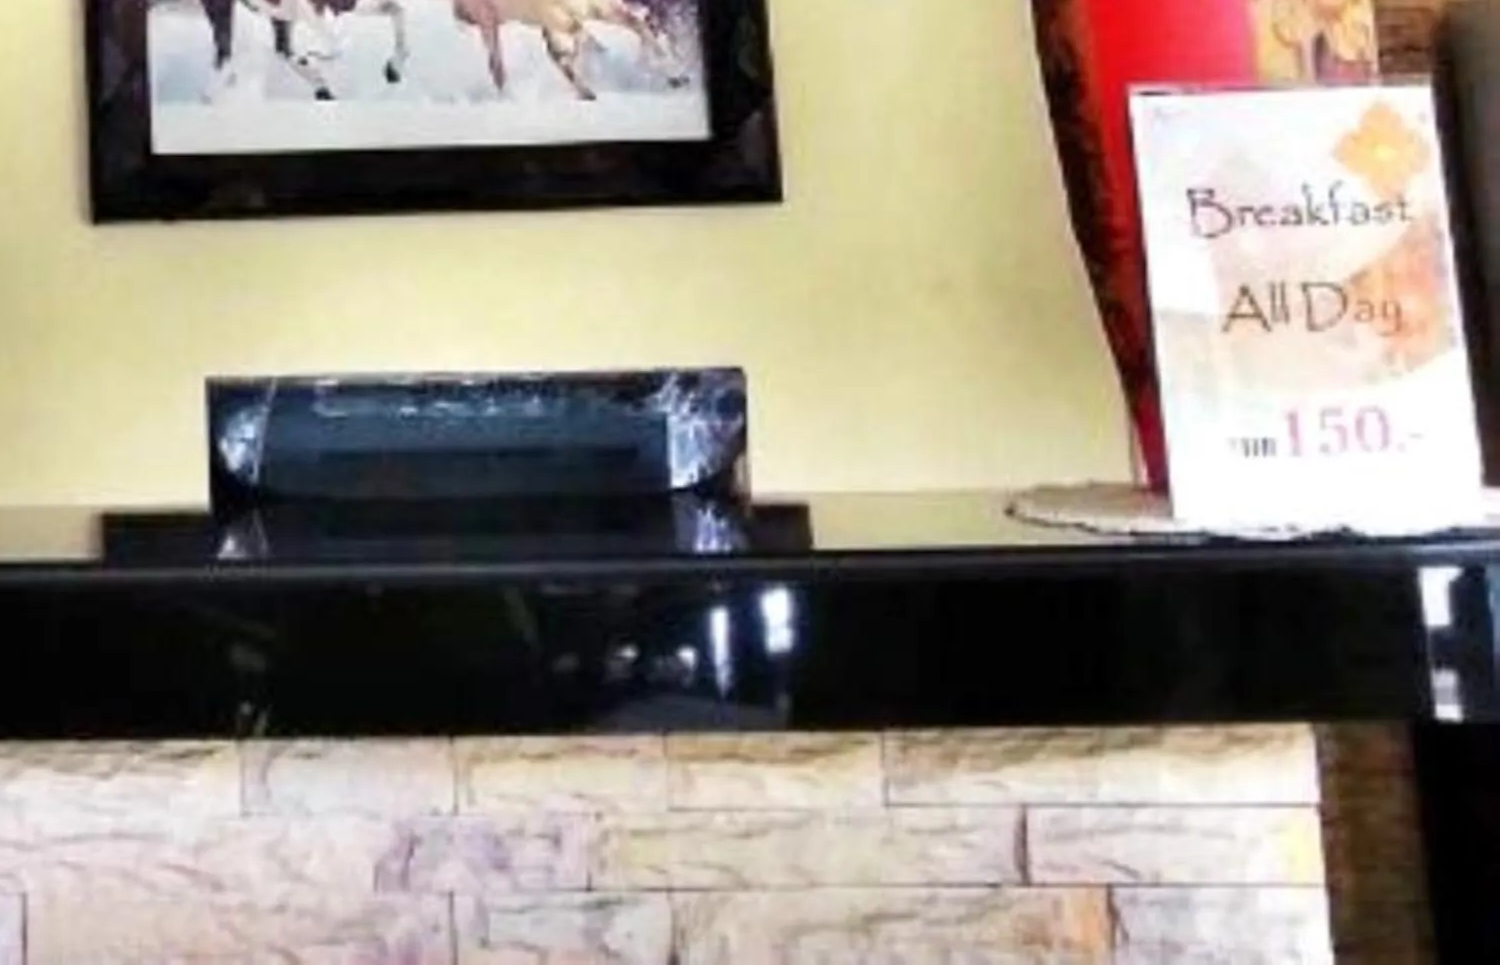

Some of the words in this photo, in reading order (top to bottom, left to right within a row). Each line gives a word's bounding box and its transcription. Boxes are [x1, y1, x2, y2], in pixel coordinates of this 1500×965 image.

[1186, 180, 1414, 239] Breakfast
[1220, 281, 1291, 333] All
[1298, 280, 1402, 337] Day
